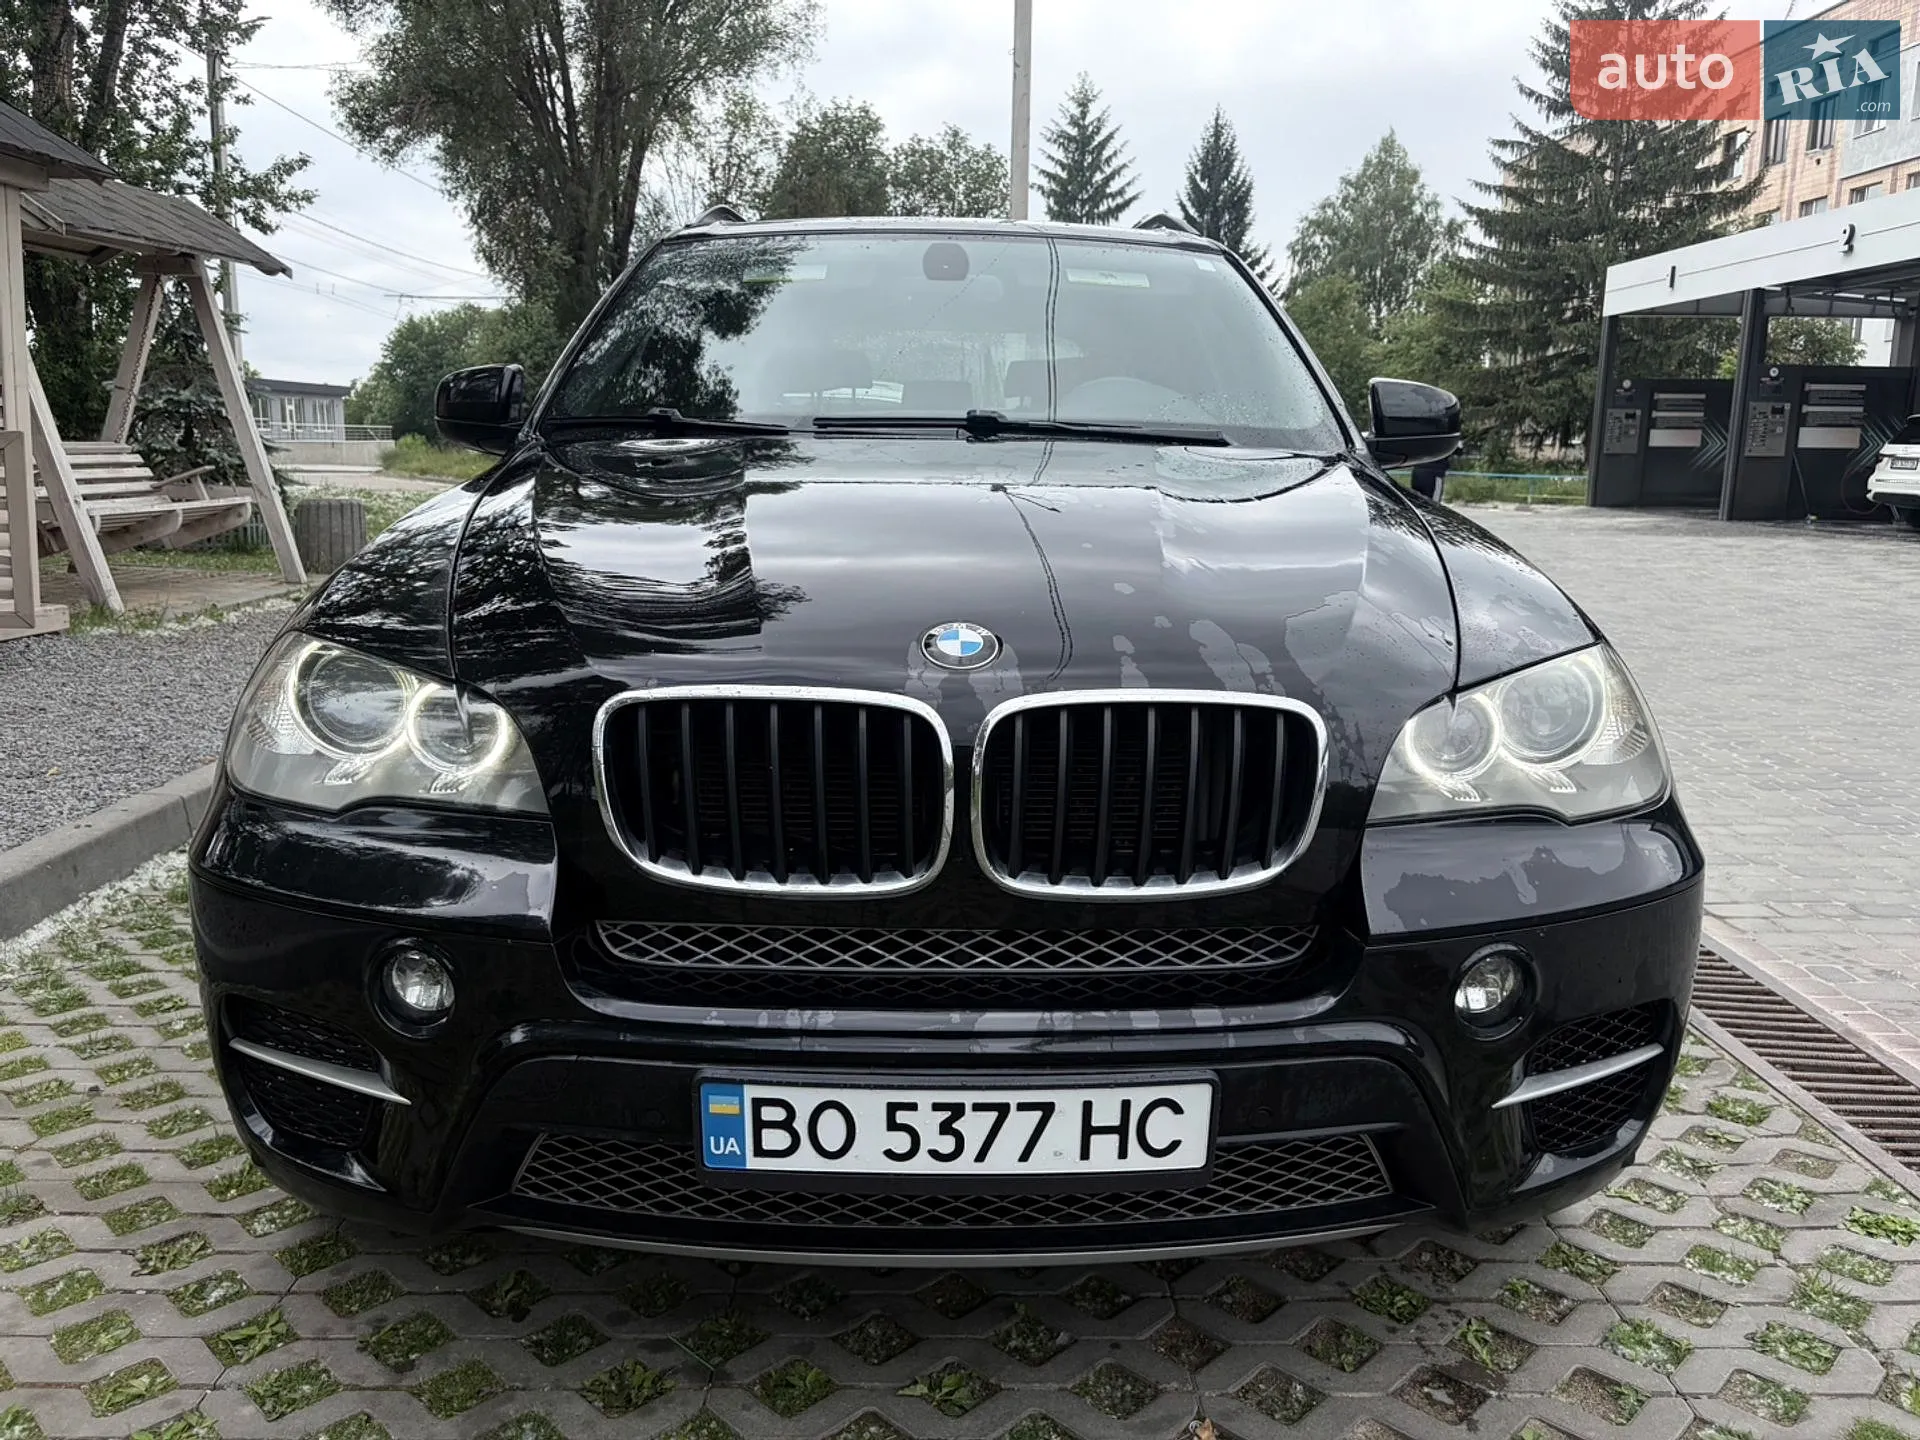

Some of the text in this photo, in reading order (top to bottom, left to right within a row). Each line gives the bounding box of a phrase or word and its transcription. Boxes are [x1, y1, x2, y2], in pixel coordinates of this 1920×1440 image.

[709, 1136, 741, 1156] UA
[751, 1097, 1185, 1163] BO 5377 HC
